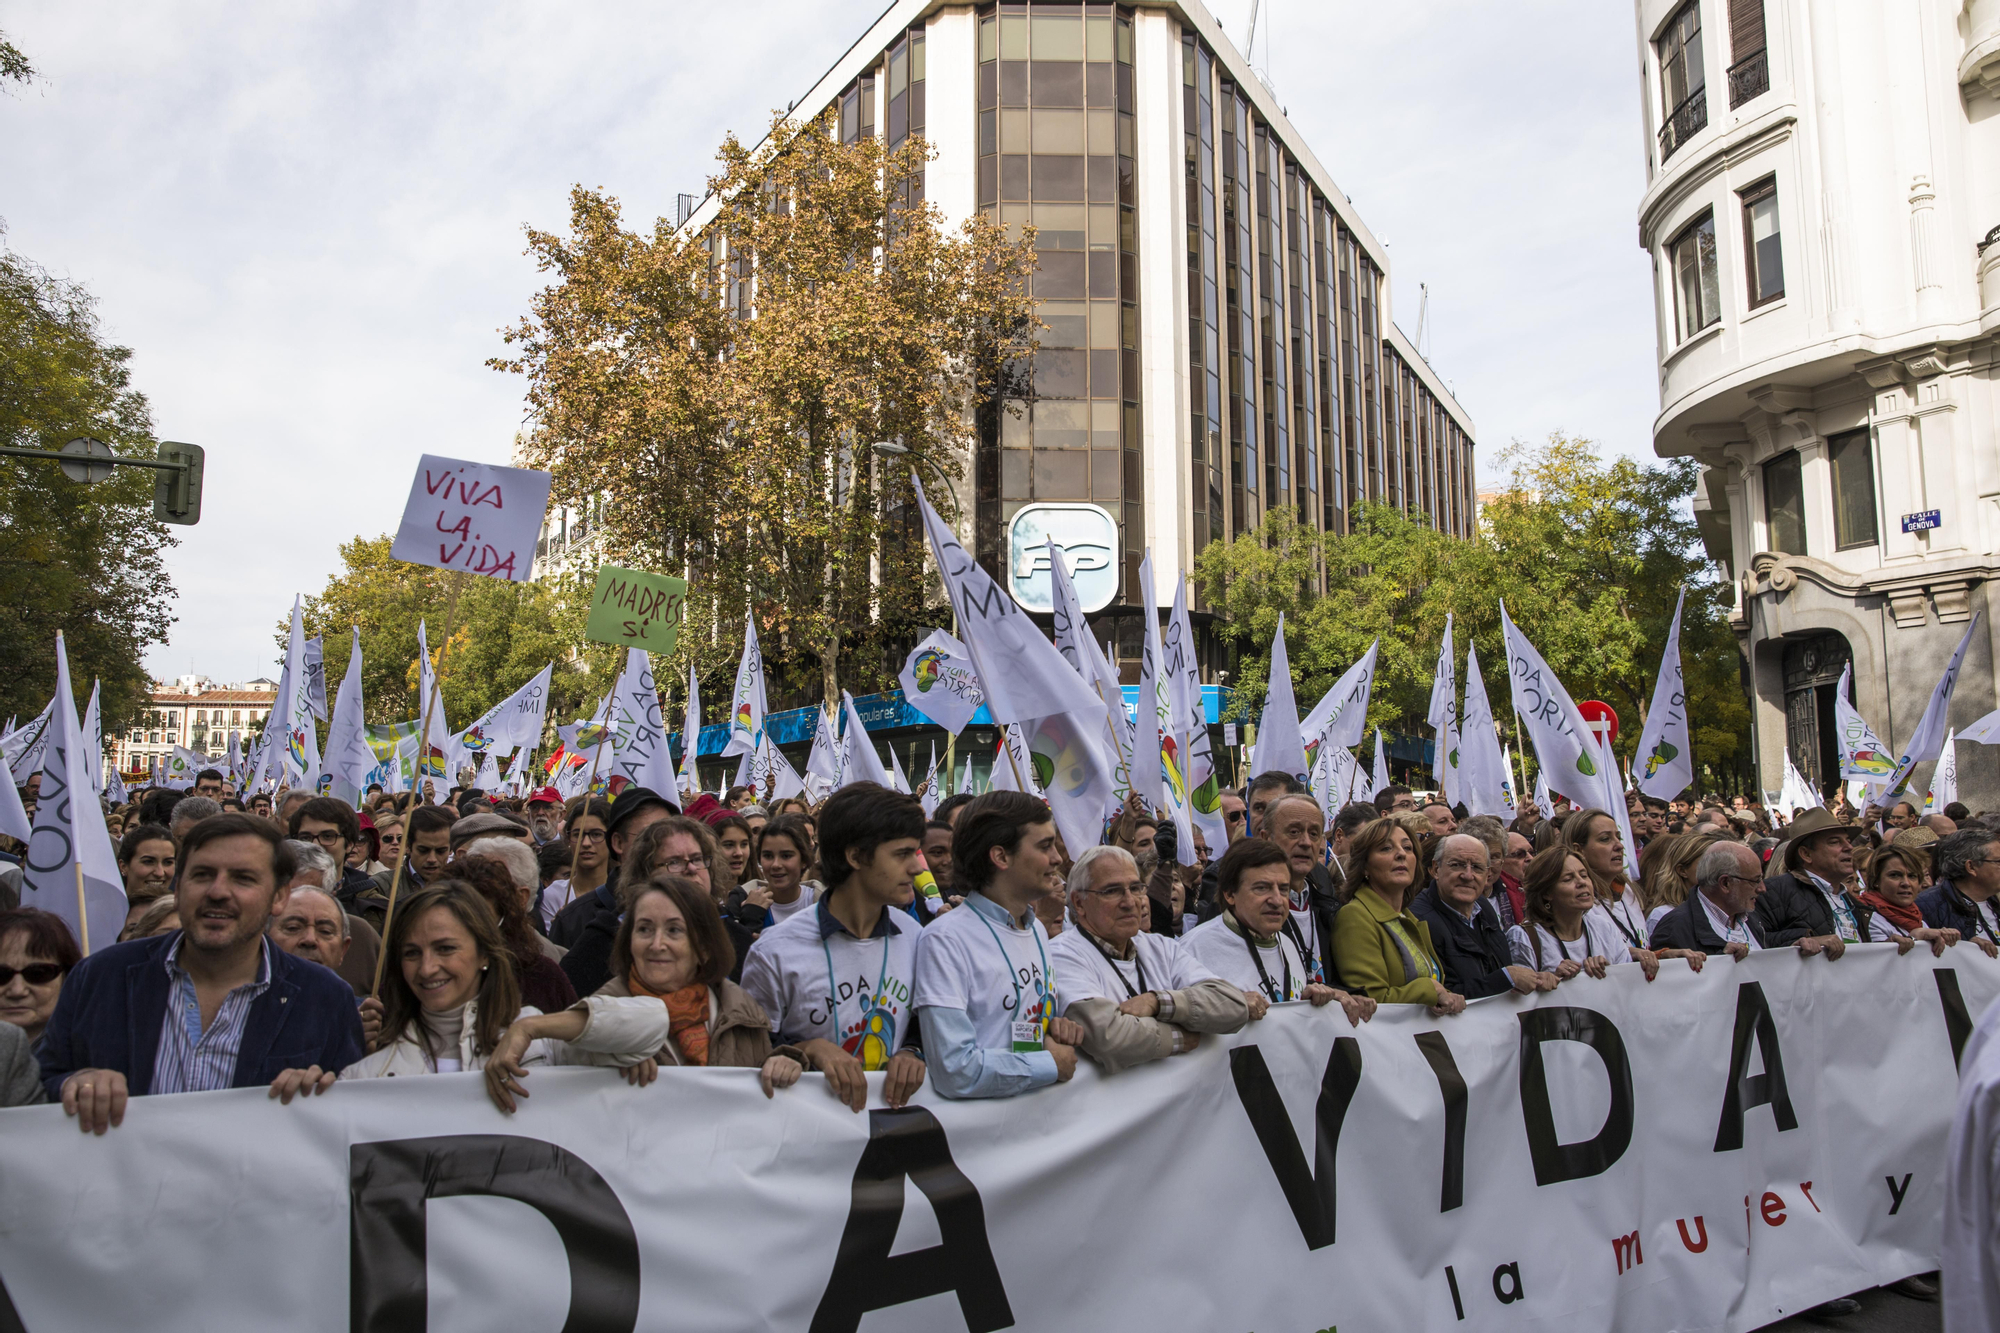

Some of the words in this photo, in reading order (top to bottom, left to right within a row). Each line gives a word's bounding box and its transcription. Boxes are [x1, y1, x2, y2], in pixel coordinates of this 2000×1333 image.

[436, 510, 473, 542] LA
[1911, 511, 1938, 519] CALLE
[601, 577, 683, 631] MADRES
[809, 974, 870, 1026] CADA
[1229, 981, 1799, 1252] VIDA
[1445, 1261, 1525, 1321] la
[1612, 1180, 1821, 1276] mujer
[1886, 1173, 1913, 1215] y
